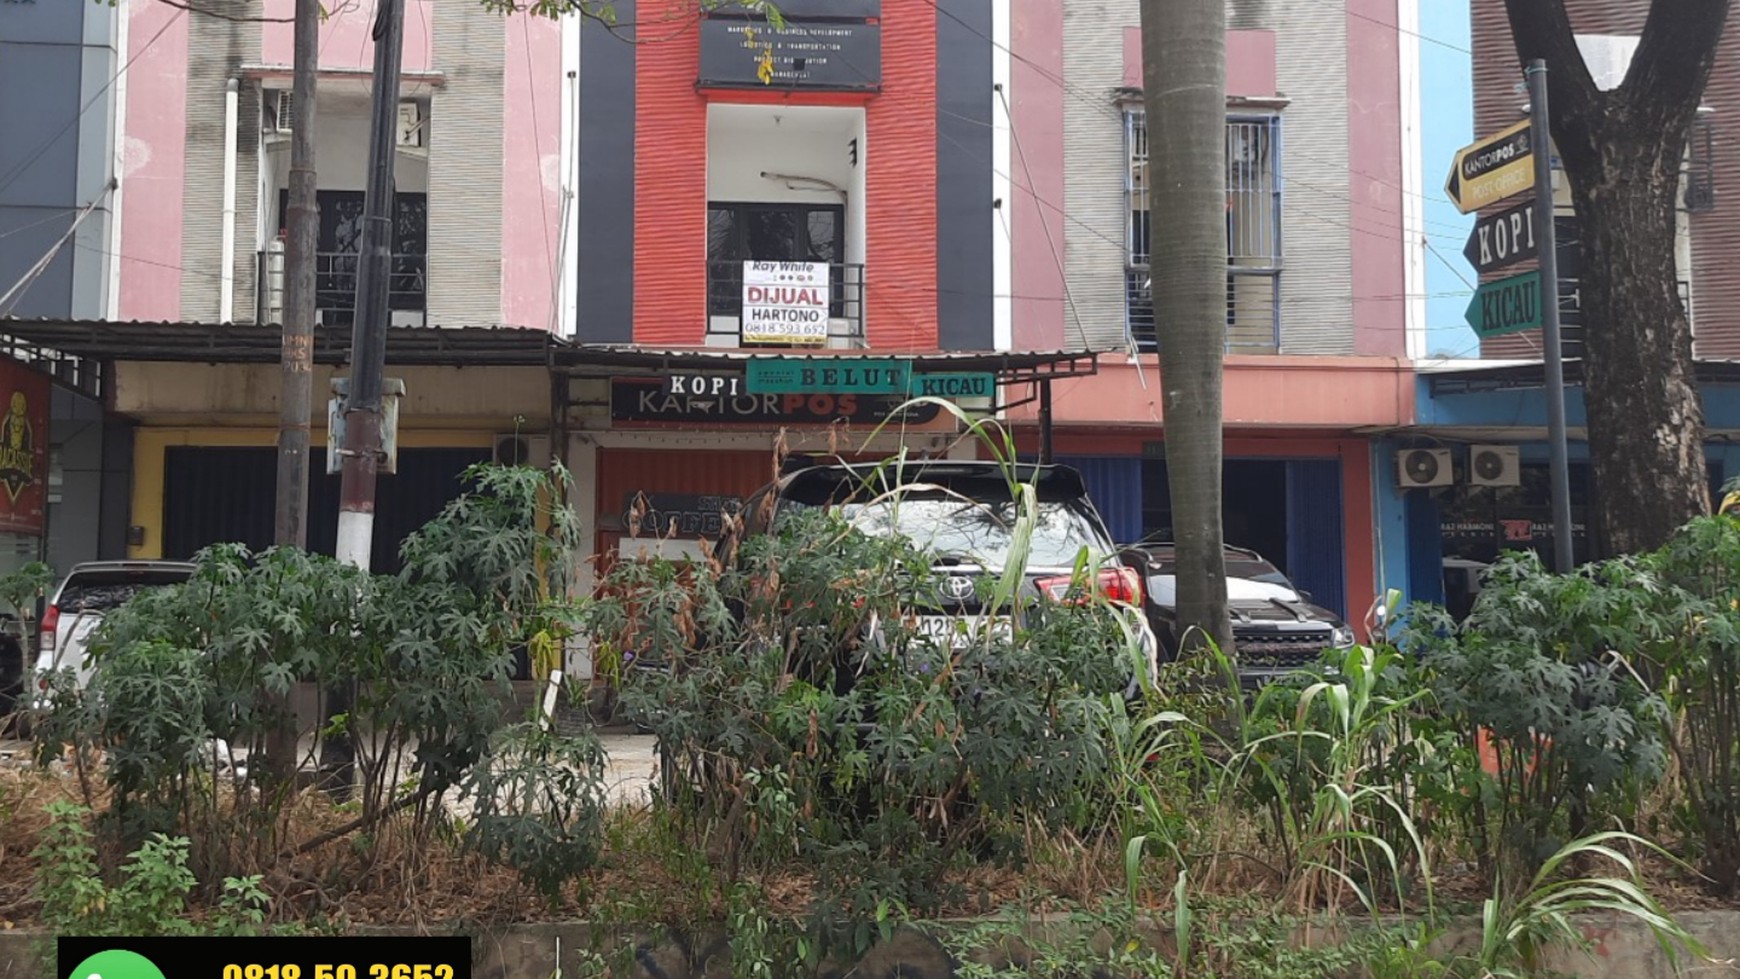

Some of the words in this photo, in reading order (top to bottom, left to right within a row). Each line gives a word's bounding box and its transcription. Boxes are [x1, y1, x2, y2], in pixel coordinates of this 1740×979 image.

[739, 41, 773, 49] LOSTICS
[1465, 143, 1515, 174] KANTORPOS
[1472, 179, 1495, 200] POST
[1495, 168, 1525, 191] OFFICE
[1478, 206, 1534, 266] KOPI
[752, 261, 776, 272] Ray
[779, 261, 814, 272] White
[747, 287, 823, 305] DIJUAL
[1481, 280, 1536, 331] KICAU
[752, 309, 819, 322] HARTONO
[745, 322, 775, 333] 0818
[780, 324, 800, 334] 593
[804, 325, 825, 335] 652
[670, 375, 738, 395] KOPI
[801, 368, 901, 386] BELUT
[921, 377, 986, 396] KICAU
